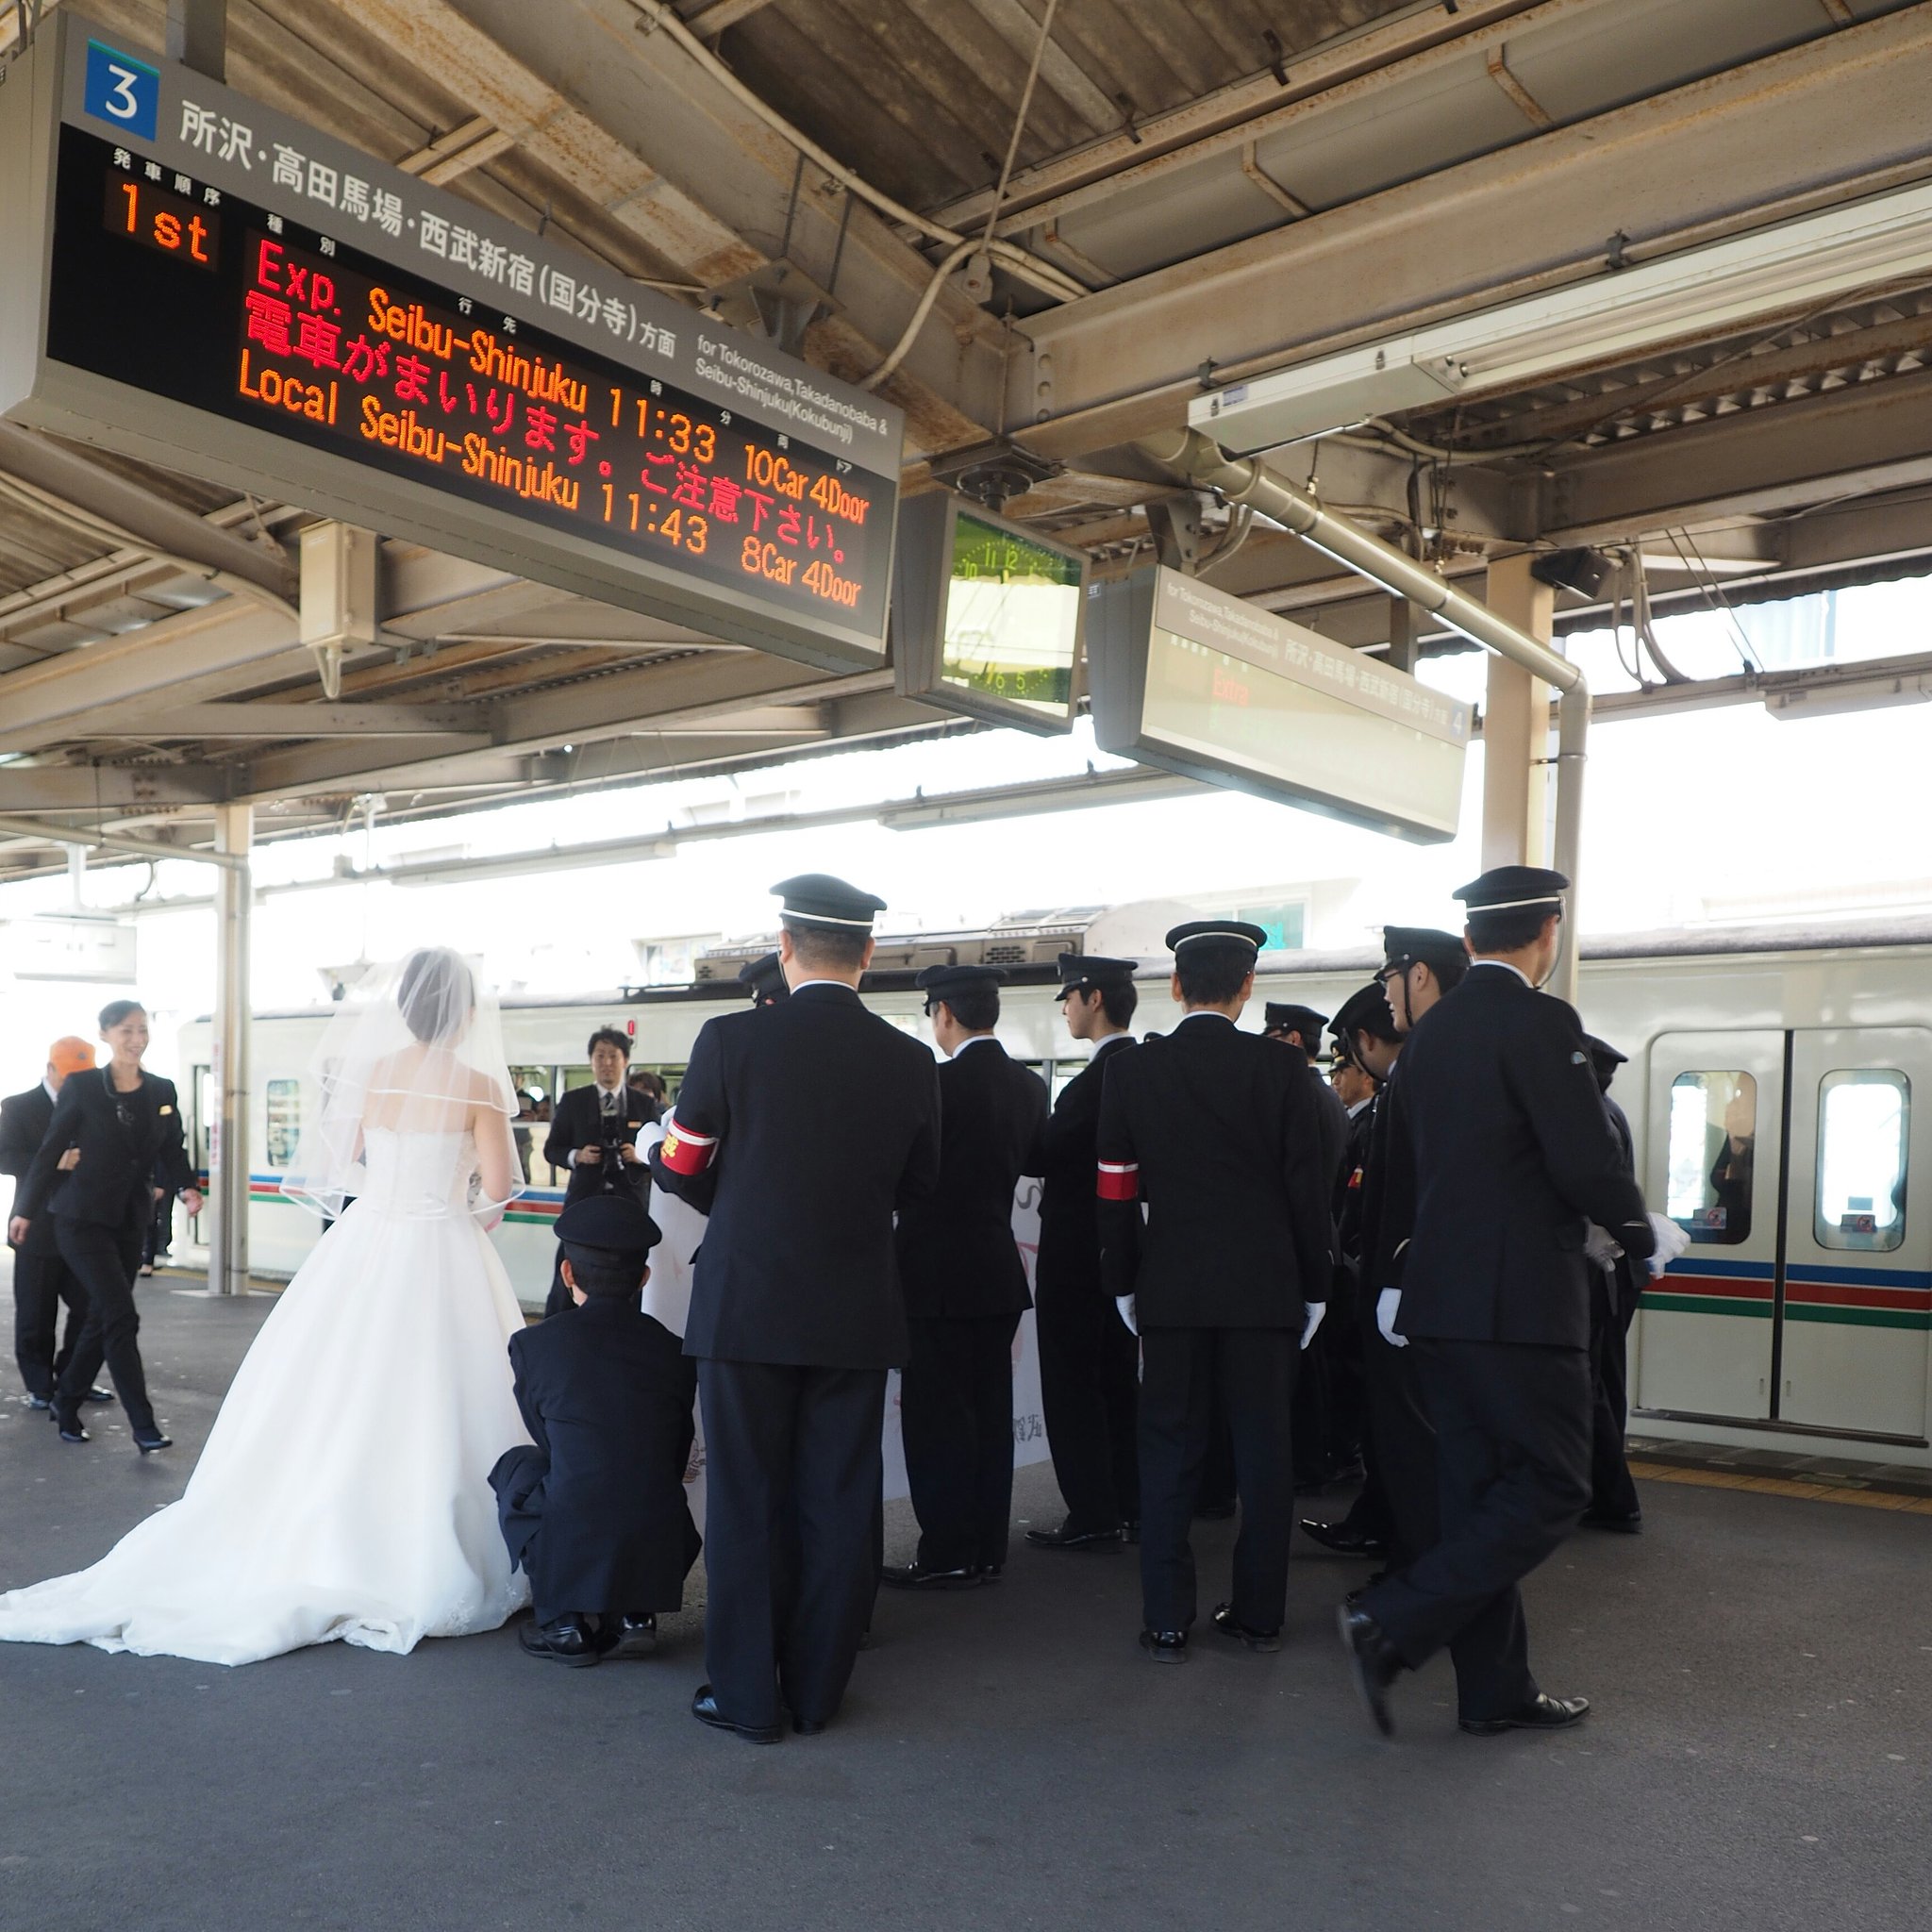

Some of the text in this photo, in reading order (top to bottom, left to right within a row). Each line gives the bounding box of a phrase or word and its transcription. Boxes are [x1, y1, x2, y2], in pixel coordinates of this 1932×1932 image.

[105, 63, 138, 119] 3
[123, 183, 208, 262] 1st
[258, 239, 870, 525] Exp. Seibu-Shinjuku 11:33 10Car 4Door
[697, 334, 717, 357] for
[878, 419, 888, 436] &
[239, 348, 861, 607] Local Seibu-Shinjuku 11:43 8Car 4Door
[985, 546, 997, 569] 11
[1005, 549, 1018, 571] 12
[1212, 667, 1250, 706] Extra
[1452, 711, 1463, 735] 4
